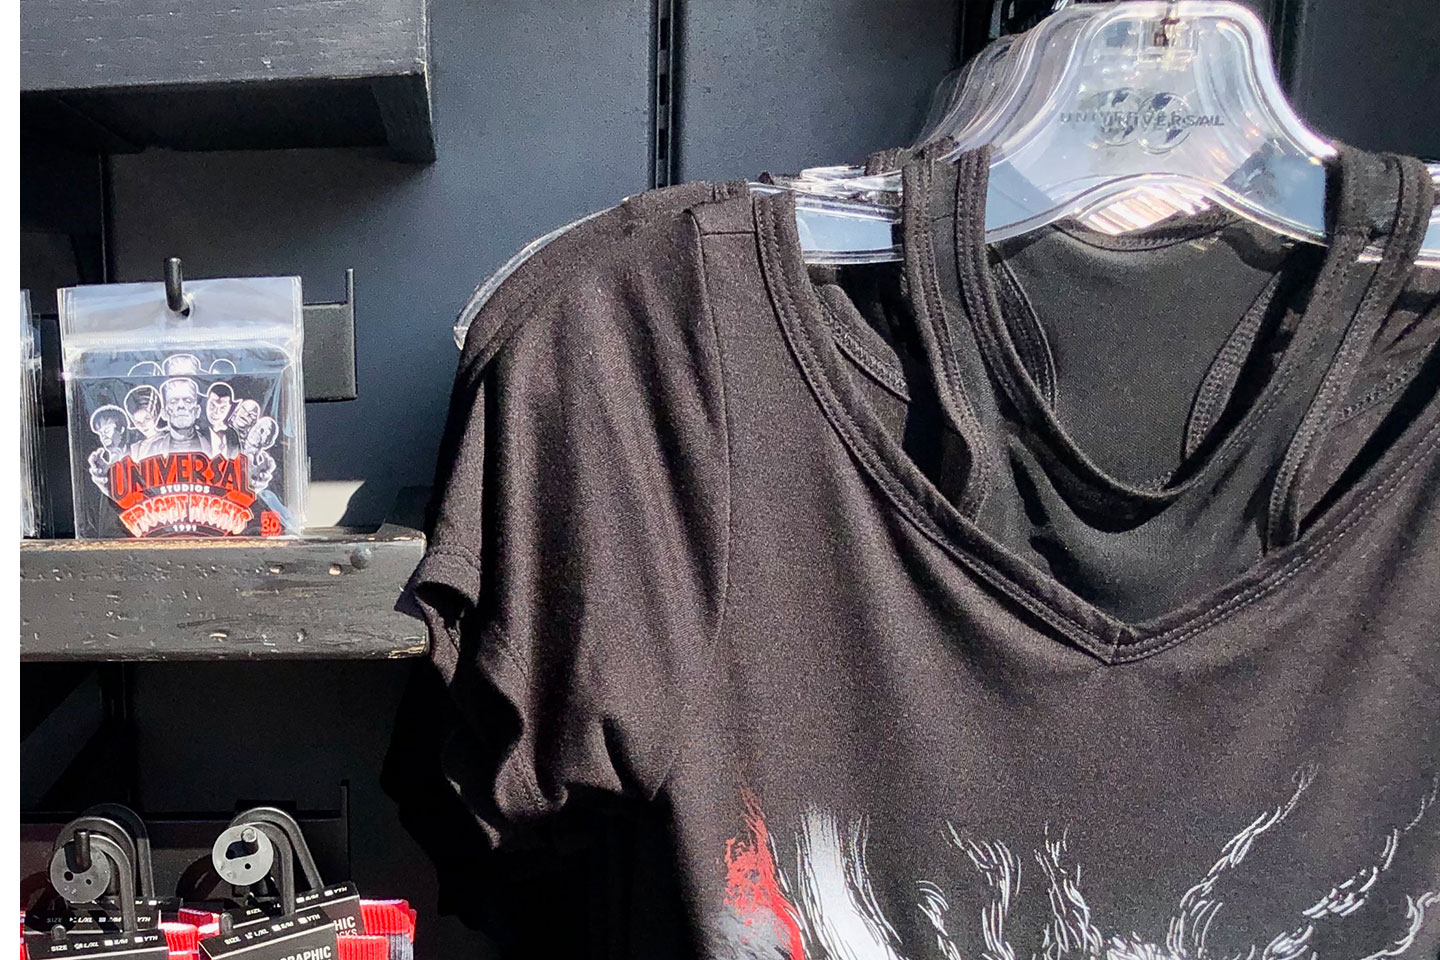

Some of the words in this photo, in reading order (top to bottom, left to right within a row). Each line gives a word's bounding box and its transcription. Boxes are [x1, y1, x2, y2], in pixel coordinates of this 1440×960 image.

[111, 452, 257, 500] UNIVERSAL
[160, 483, 210, 494] STUDIOS
[119, 495, 188, 538] FRIGHT
[189, 494, 254, 535] NIGHTS
[172, 524, 197, 532] 1991
